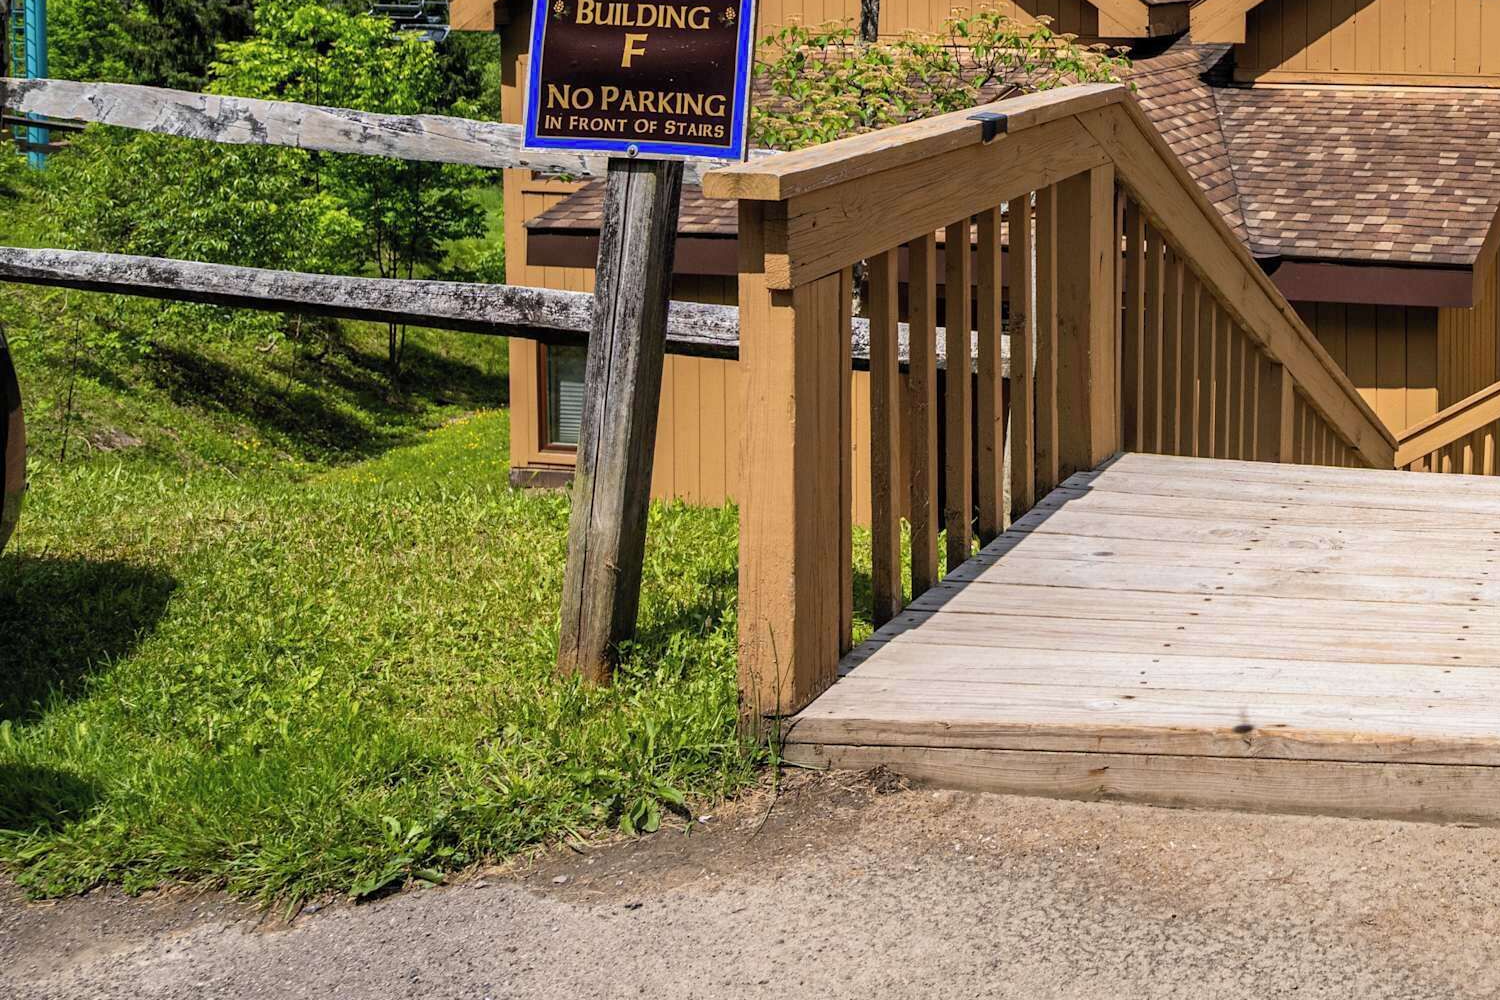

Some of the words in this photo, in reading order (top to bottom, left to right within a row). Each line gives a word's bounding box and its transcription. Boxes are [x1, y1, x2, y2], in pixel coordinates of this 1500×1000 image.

[620, 33, 649, 68] F
[547, 83, 594, 110] NO
[600, 85, 727, 117] PARKING
[544, 114, 562, 130] IN
[569, 115, 628, 132] FRONT
[633, 118, 658, 134] OF
[664, 119, 725, 138] STAIRS
